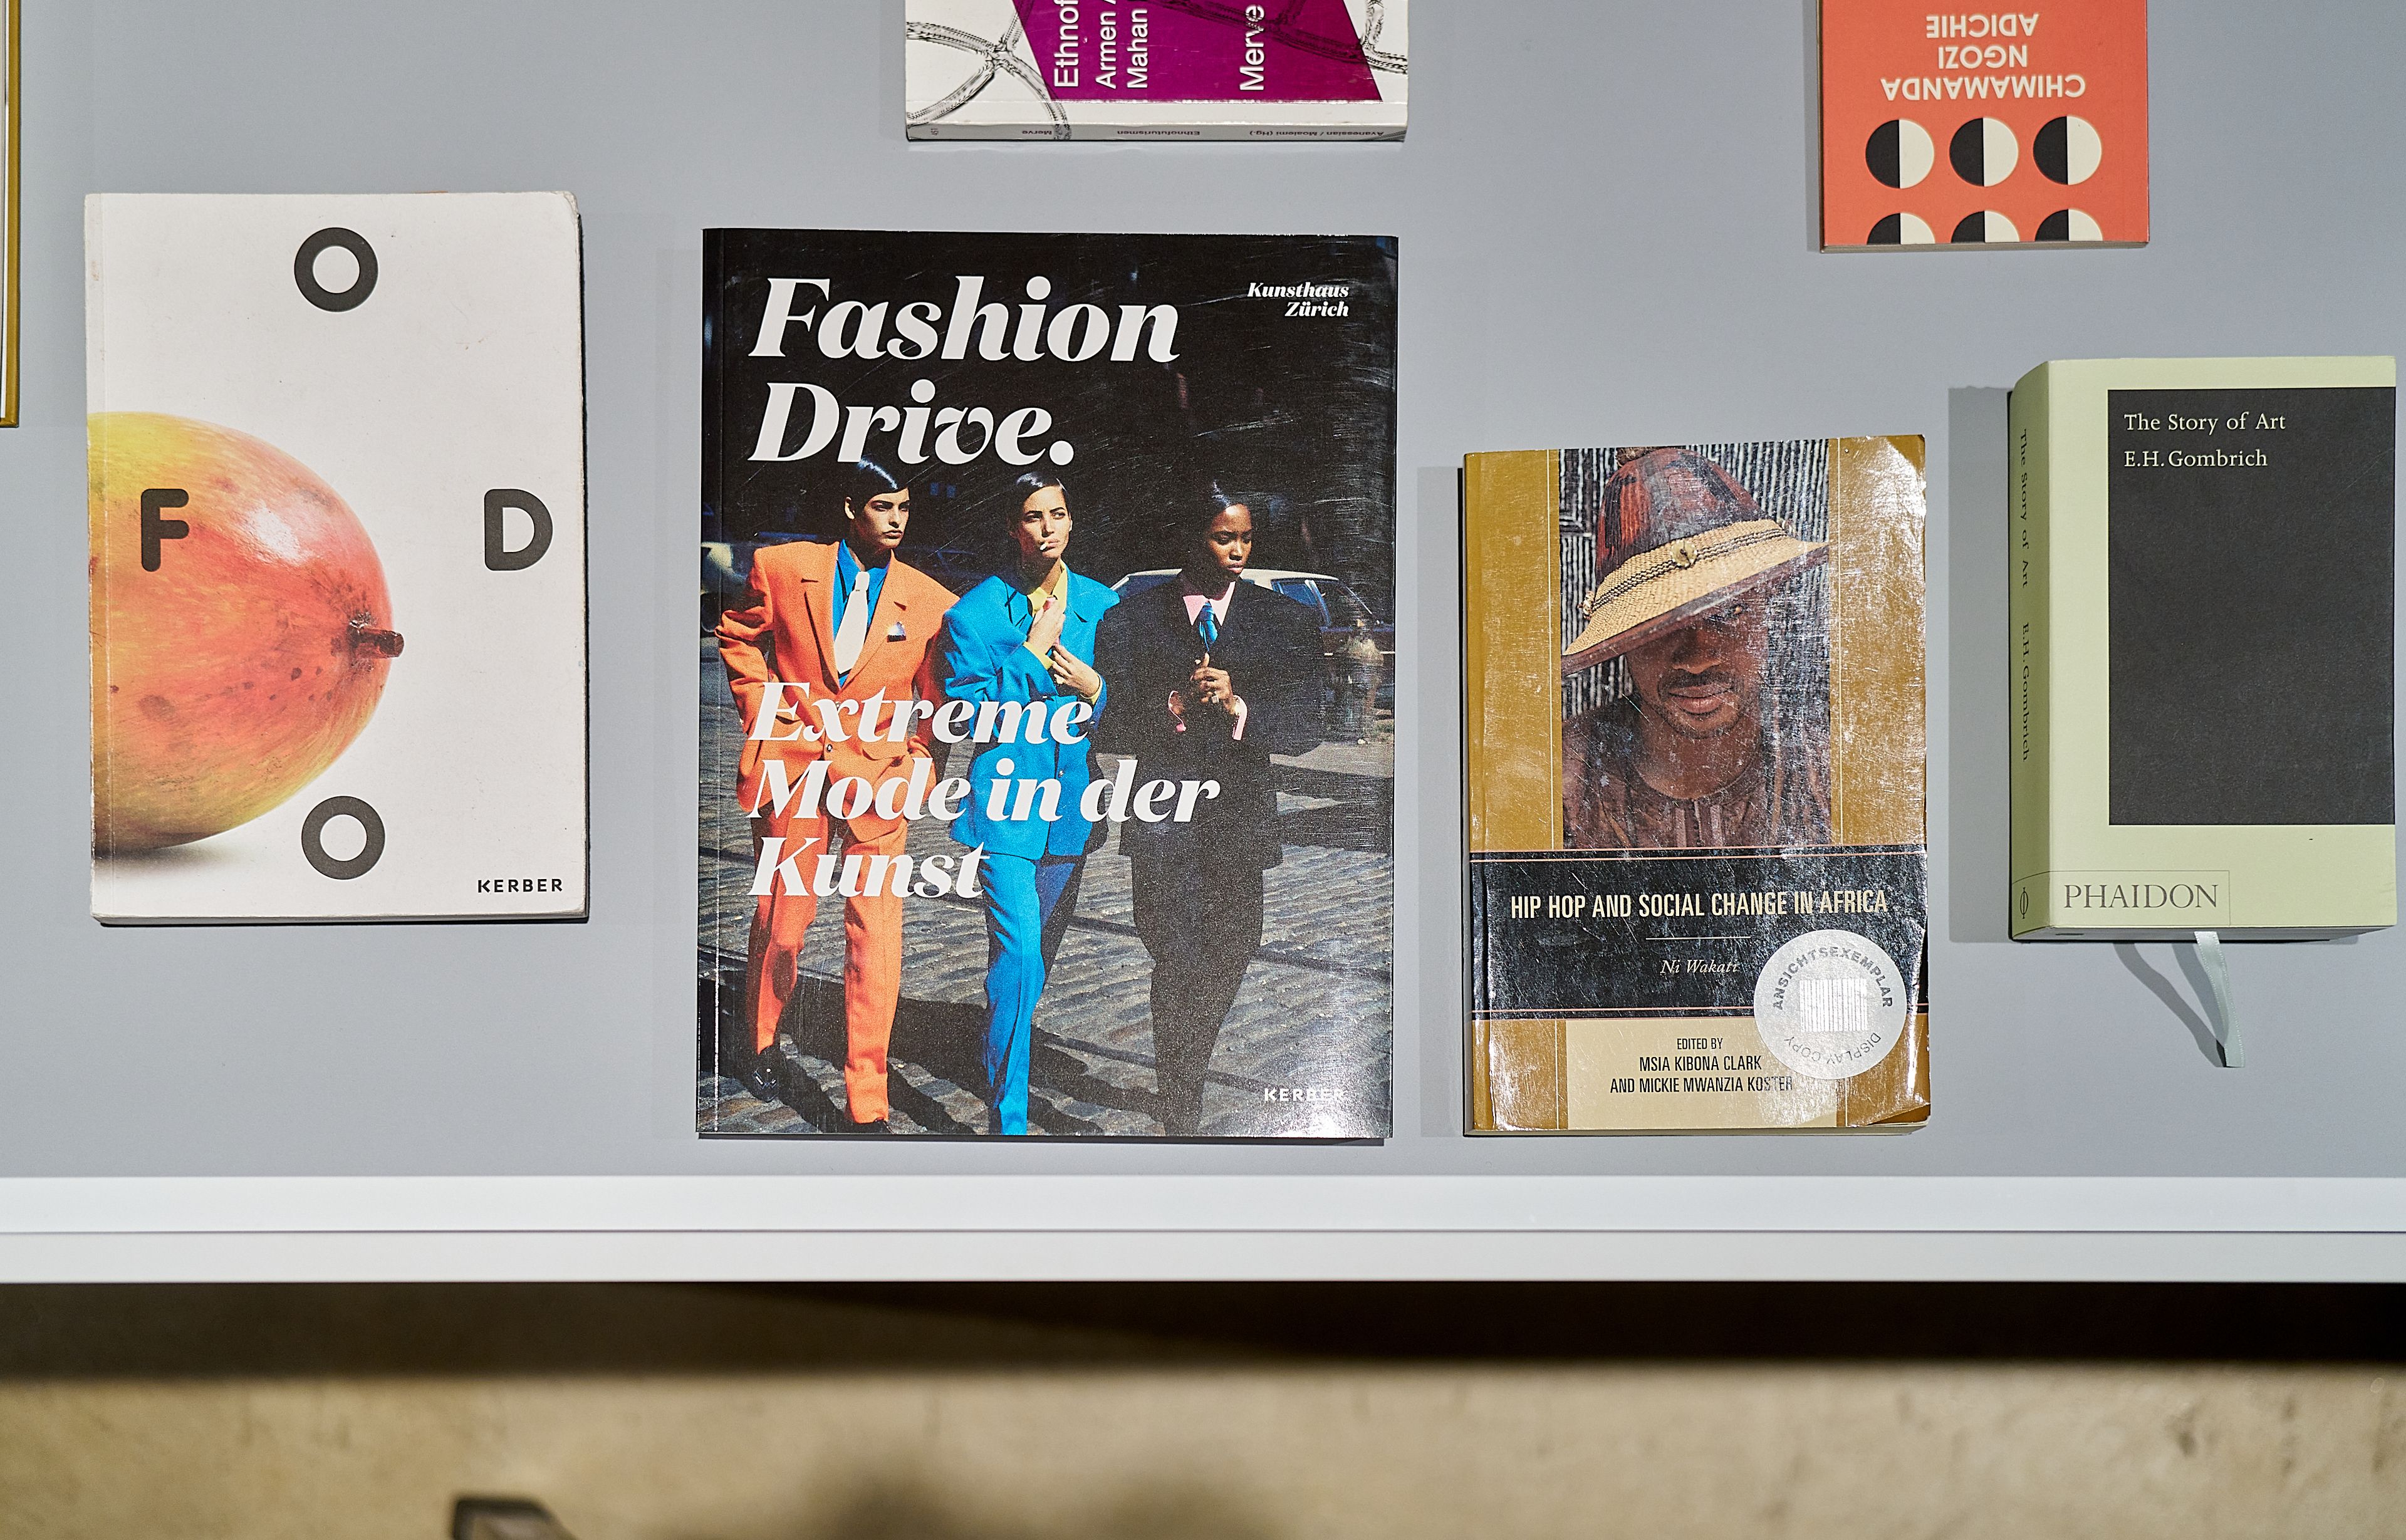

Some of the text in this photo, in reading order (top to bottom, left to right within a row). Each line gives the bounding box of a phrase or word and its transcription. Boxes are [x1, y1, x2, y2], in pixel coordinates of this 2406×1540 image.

[1926, 14, 2038, 38] ADICHIE
[1096, 12, 1117, 90] Armen
[1127, 9, 1148, 88] Mahan
[1239, 5, 1264, 90] Merve
[1939, 45, 2027, 69] NGOZI
[1880, 75, 2085, 101] CHIMAMANDA
[1247, 282, 1349, 298] Kunsthaus
[748, 276, 1180, 362] Fashion
[1284, 301, 1349, 316] Zürich
[747, 379, 1074, 465] Drive.
[2124, 412, 2286, 435] The Story of Art
[2124, 449, 2268, 467] E.H. Gombrich
[2022, 529, 2029, 549] of
[748, 682, 1093, 744] Extreme
[746, 757, 1221, 822] Mode in der
[747, 837, 991, 898] Kunst
[477, 878, 563, 893] KERBER
[2064, 884, 2218, 908] PHAIDON
[1511, 890, 1888, 918] HIP HOP AND SOCIAL CHANGE IN AFRICA
[1660, 959, 1680, 973] Ni
[1773, 947, 1893, 1010] ANSICHTSEXEMPLAR
[1677, 1038, 1723, 1050] EDITED BY
[1784, 1032, 1882, 1064] DISPLAY COPY
[1640, 1055, 1762, 1071] MSIA KIBONA CLARK
[1264, 1088, 1346, 1101] KERBER
[1610, 1076, 1793, 1093] AND MICKIE MWANZIA KOSTER
